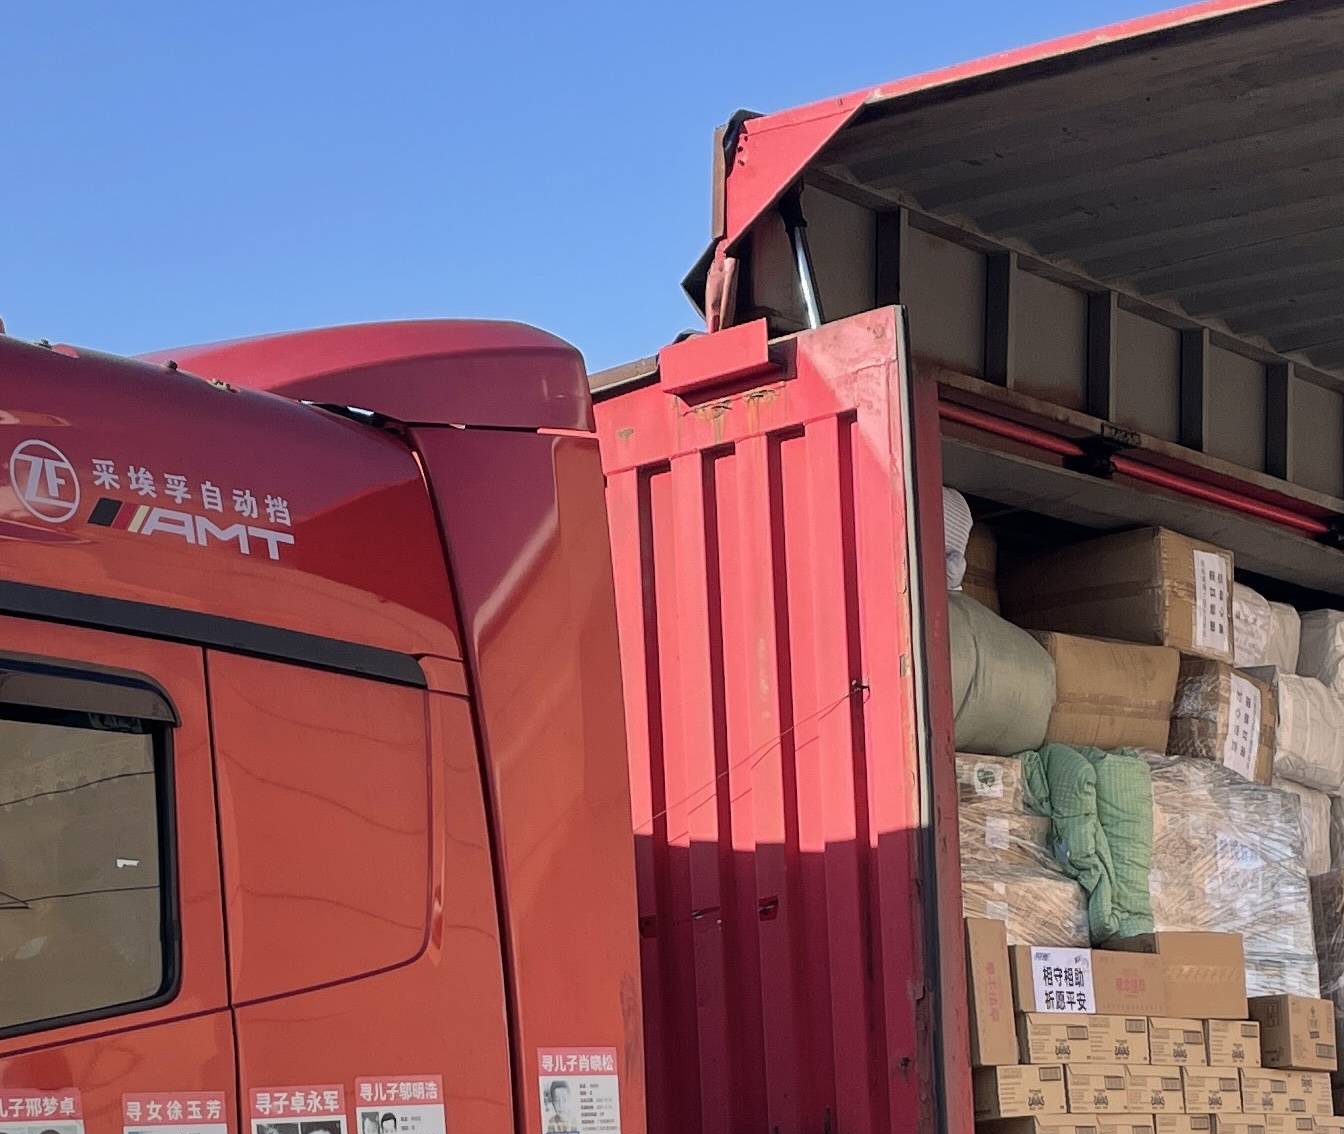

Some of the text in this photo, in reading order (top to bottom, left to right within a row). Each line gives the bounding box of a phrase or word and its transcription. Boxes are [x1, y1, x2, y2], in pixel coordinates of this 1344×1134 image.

[91, 458, 292, 527] 采埃孚自动挡
[1043, 966, 1084, 987] 相守相助
[1045, 990, 1086, 1010] 祈愿平安
[542, 1054, 614, 1072] 寻儿子肖晓松
[127, 1100, 222, 1121] 寻女徐玉芳
[255, 1090, 340, 1115] 寻子卓永军
